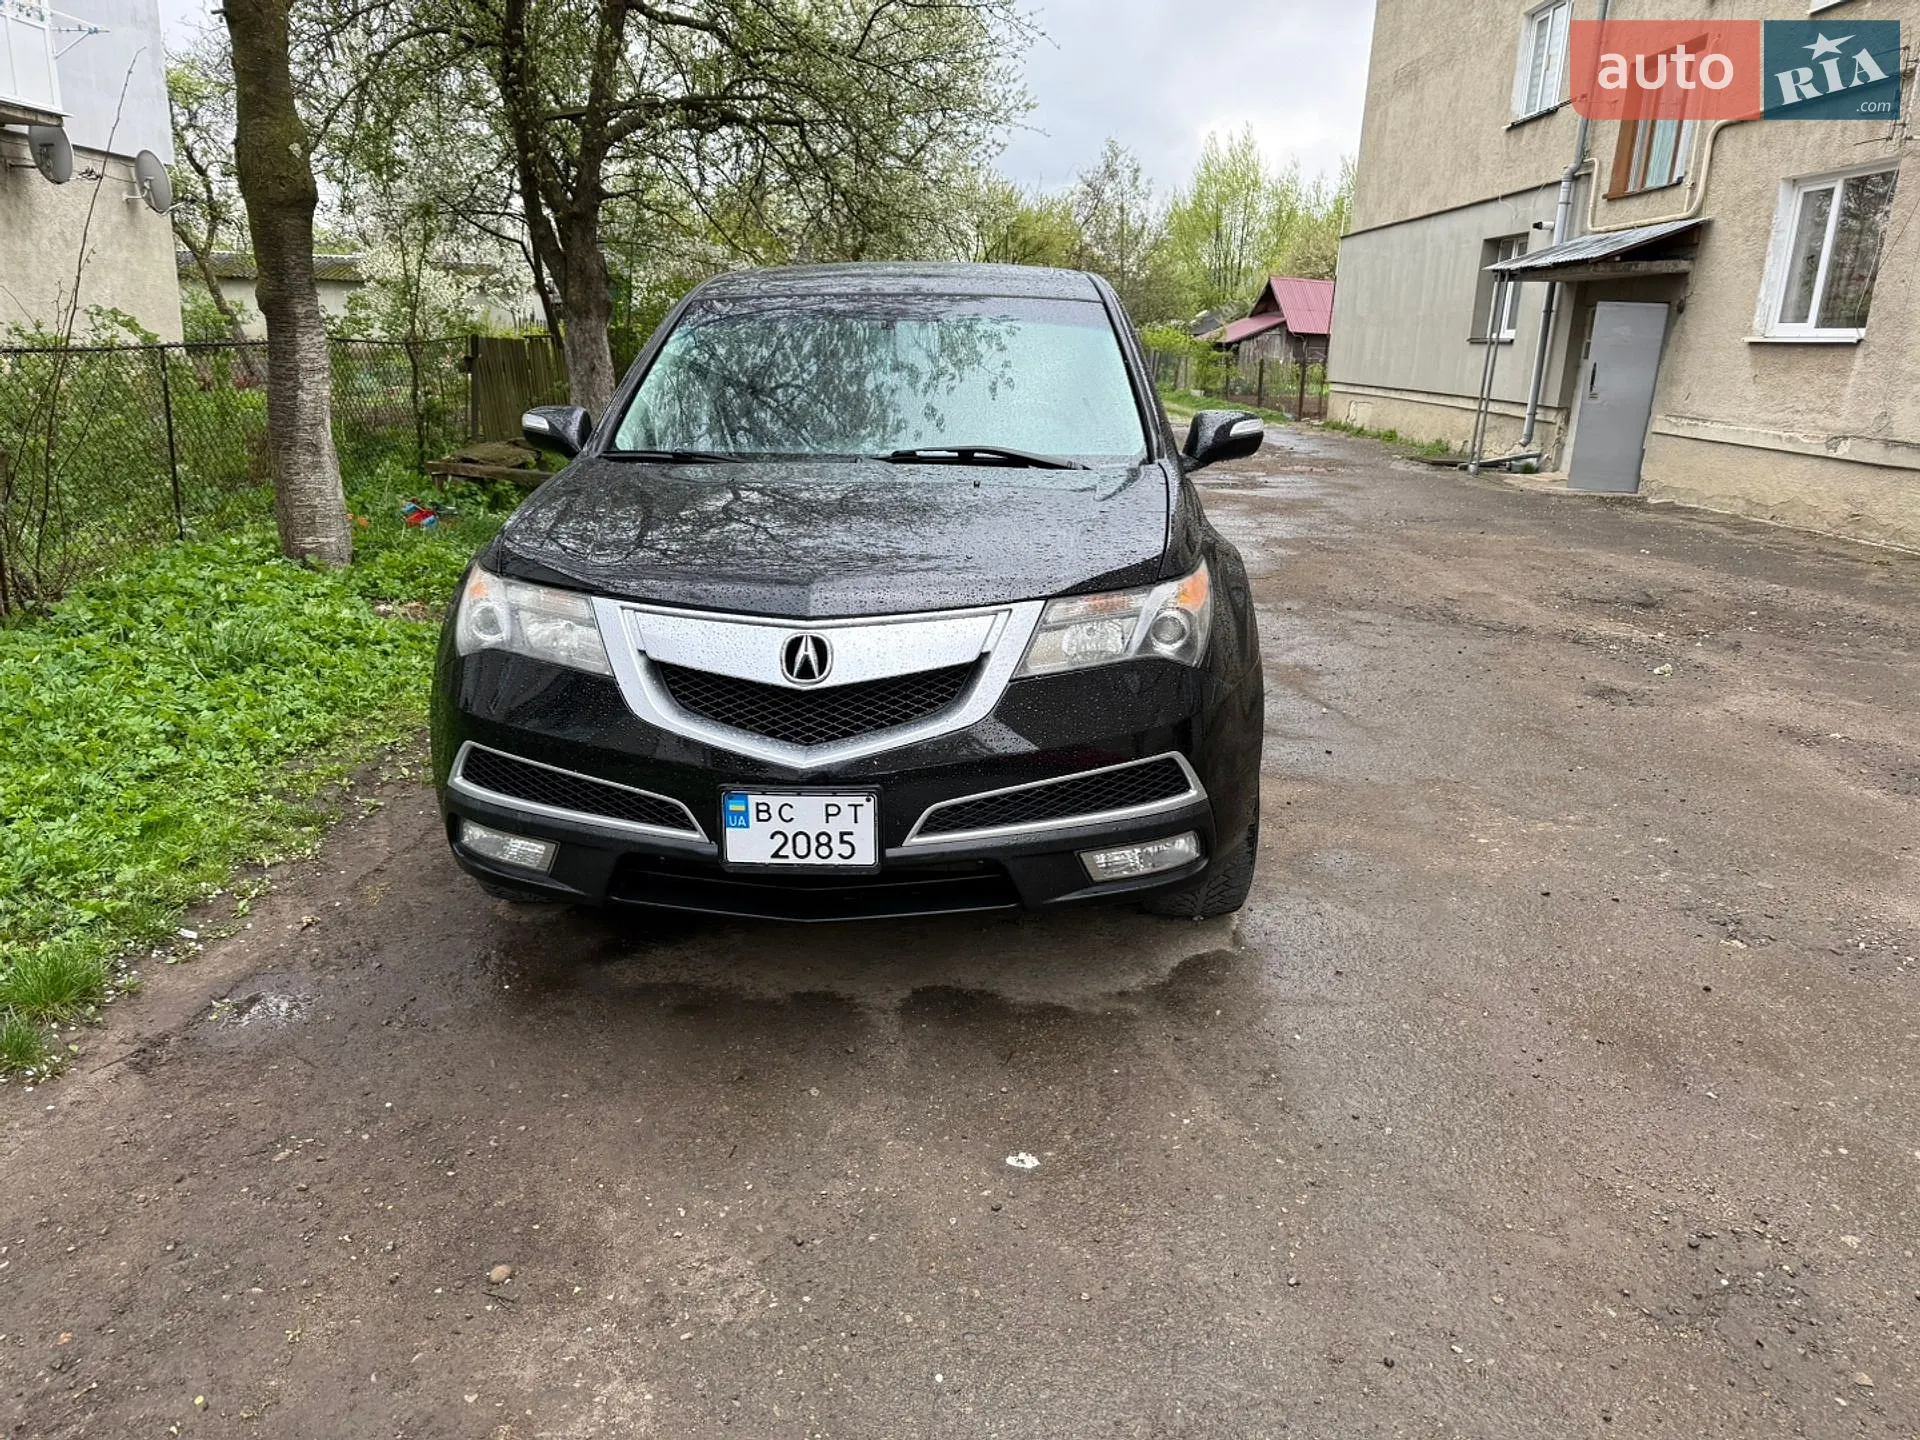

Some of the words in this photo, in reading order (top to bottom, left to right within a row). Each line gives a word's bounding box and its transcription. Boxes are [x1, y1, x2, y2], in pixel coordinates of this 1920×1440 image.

[729, 816, 747, 827] UA
[755, 802, 794, 823] BC
[825, 803, 864, 824] PT
[770, 830, 855, 860] 2085
